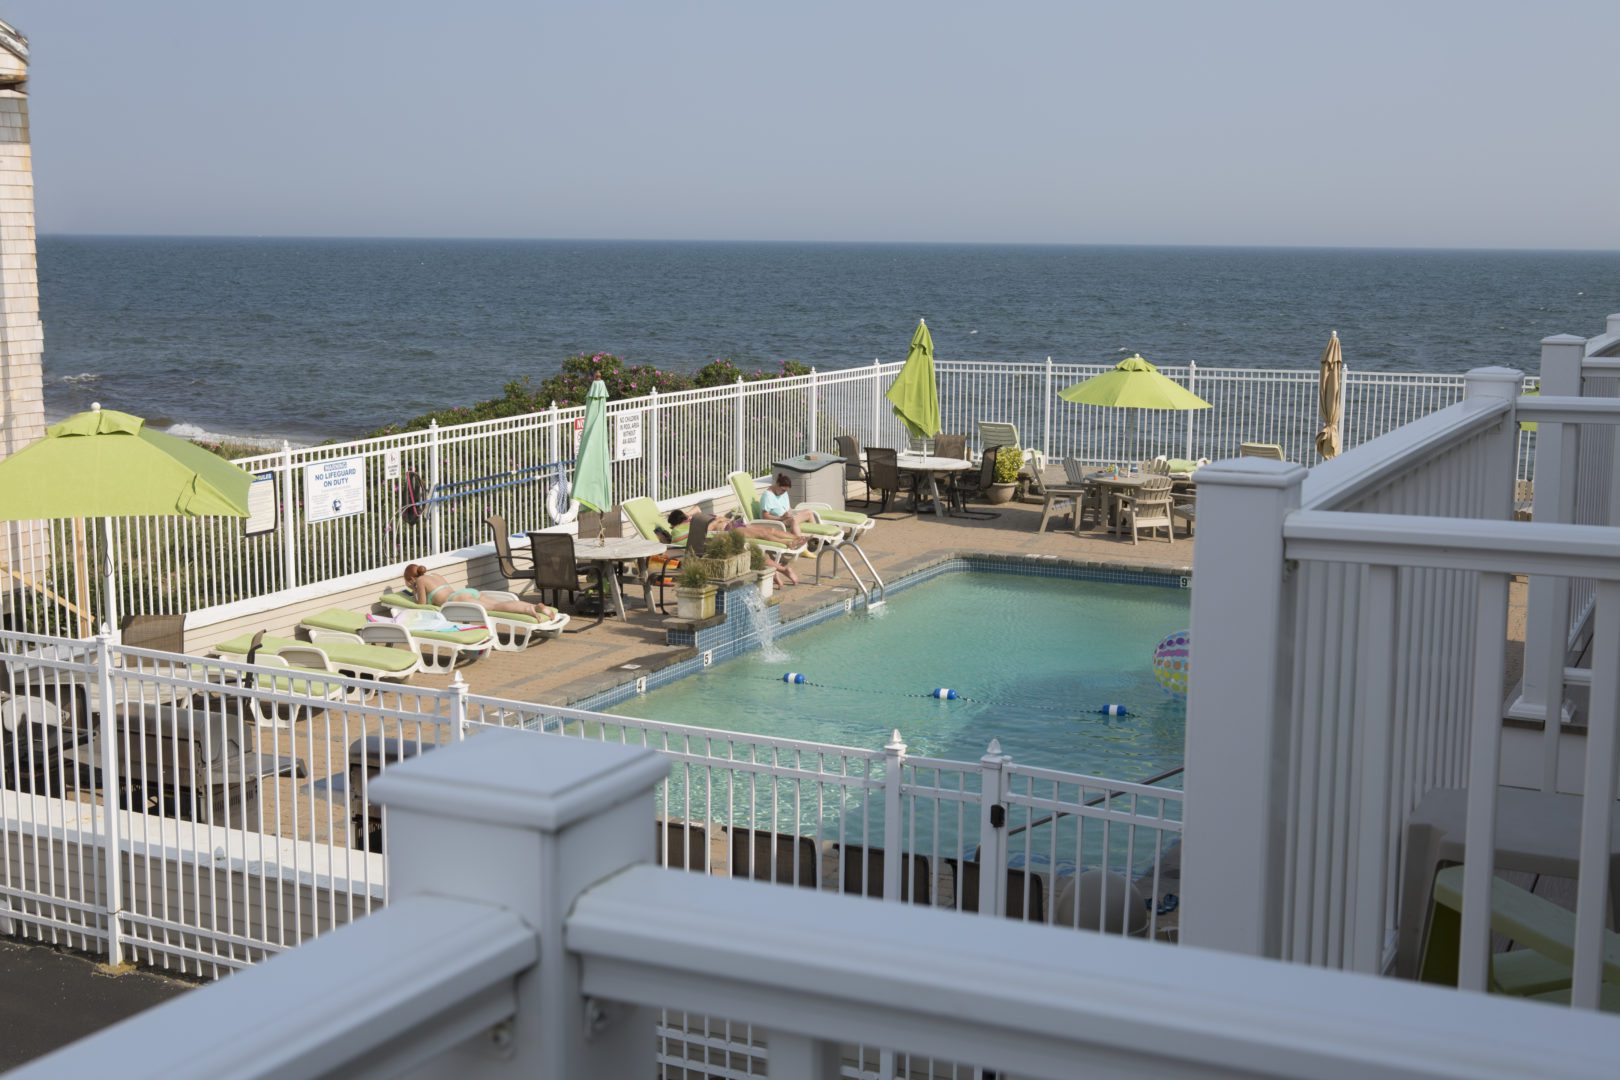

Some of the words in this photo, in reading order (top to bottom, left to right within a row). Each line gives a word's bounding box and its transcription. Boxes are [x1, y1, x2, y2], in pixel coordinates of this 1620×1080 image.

[325, 468, 356, 480] LIFEGUARD
[323, 480, 333, 488] ON
[334, 477, 348, 486] DUTY
[1181, 577, 1188, 587] 9
[704, 653, 709, 665] 5
[637, 679, 643, 690] 4
